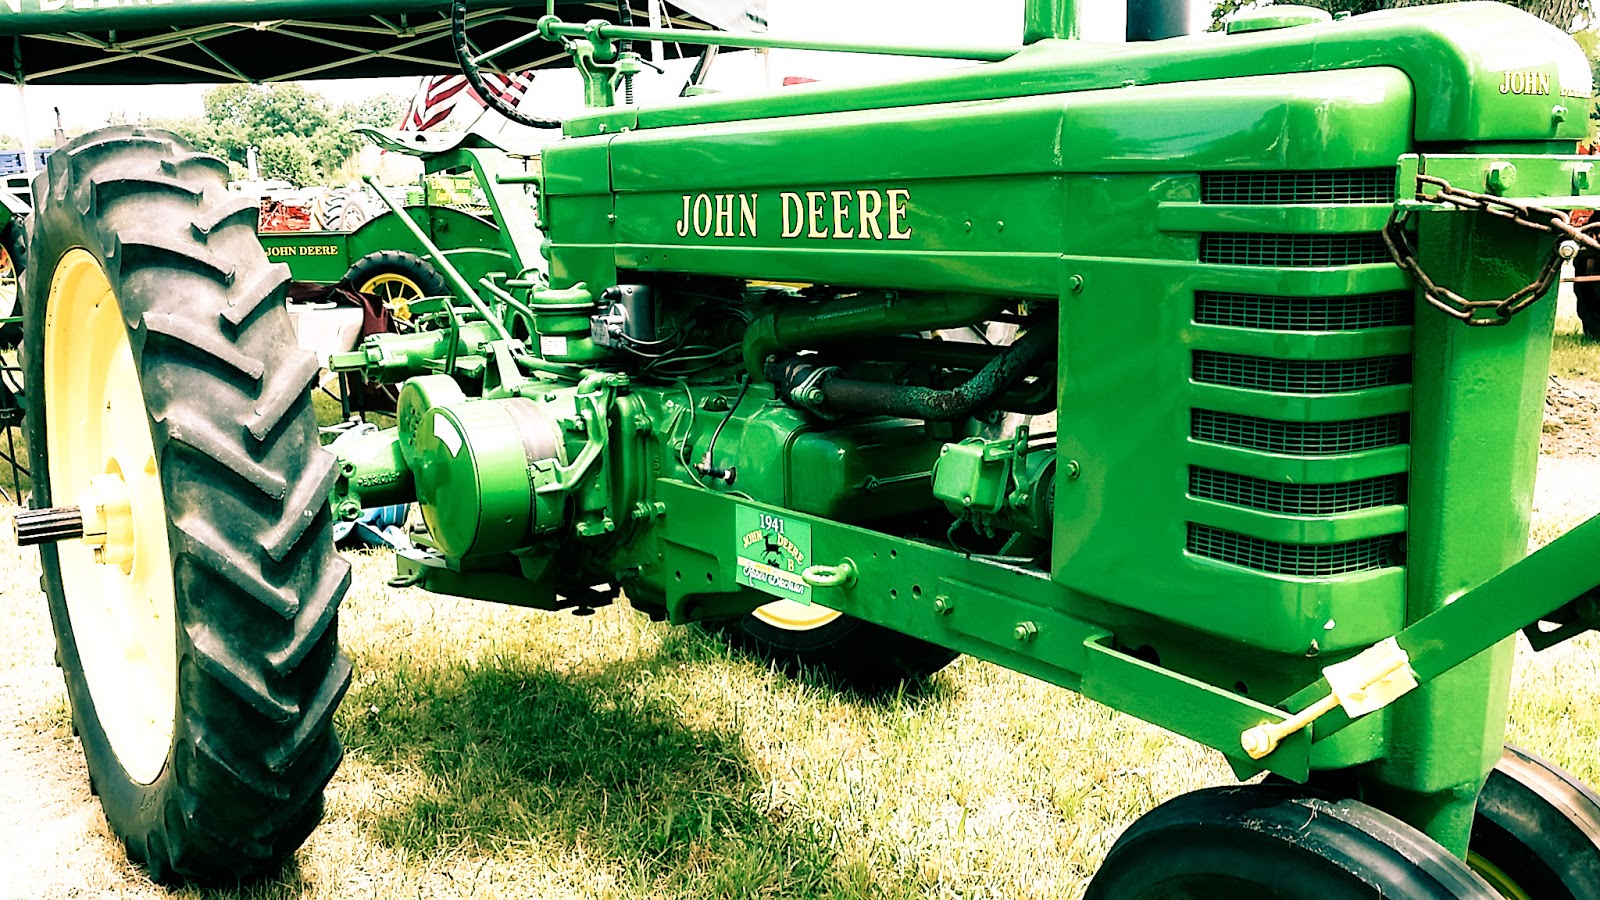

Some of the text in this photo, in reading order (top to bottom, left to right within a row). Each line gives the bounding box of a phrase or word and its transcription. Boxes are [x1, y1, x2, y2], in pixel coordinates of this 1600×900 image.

[1499, 71, 1550, 95] JOHN
[676, 189, 913, 240] JOHN DEERE
[265, 245, 338, 256] JOHN DEERE
[759, 513, 785, 534] 1941
[742, 529, 805, 566] JOHN DEERE
[787, 558, 795, 572] B
